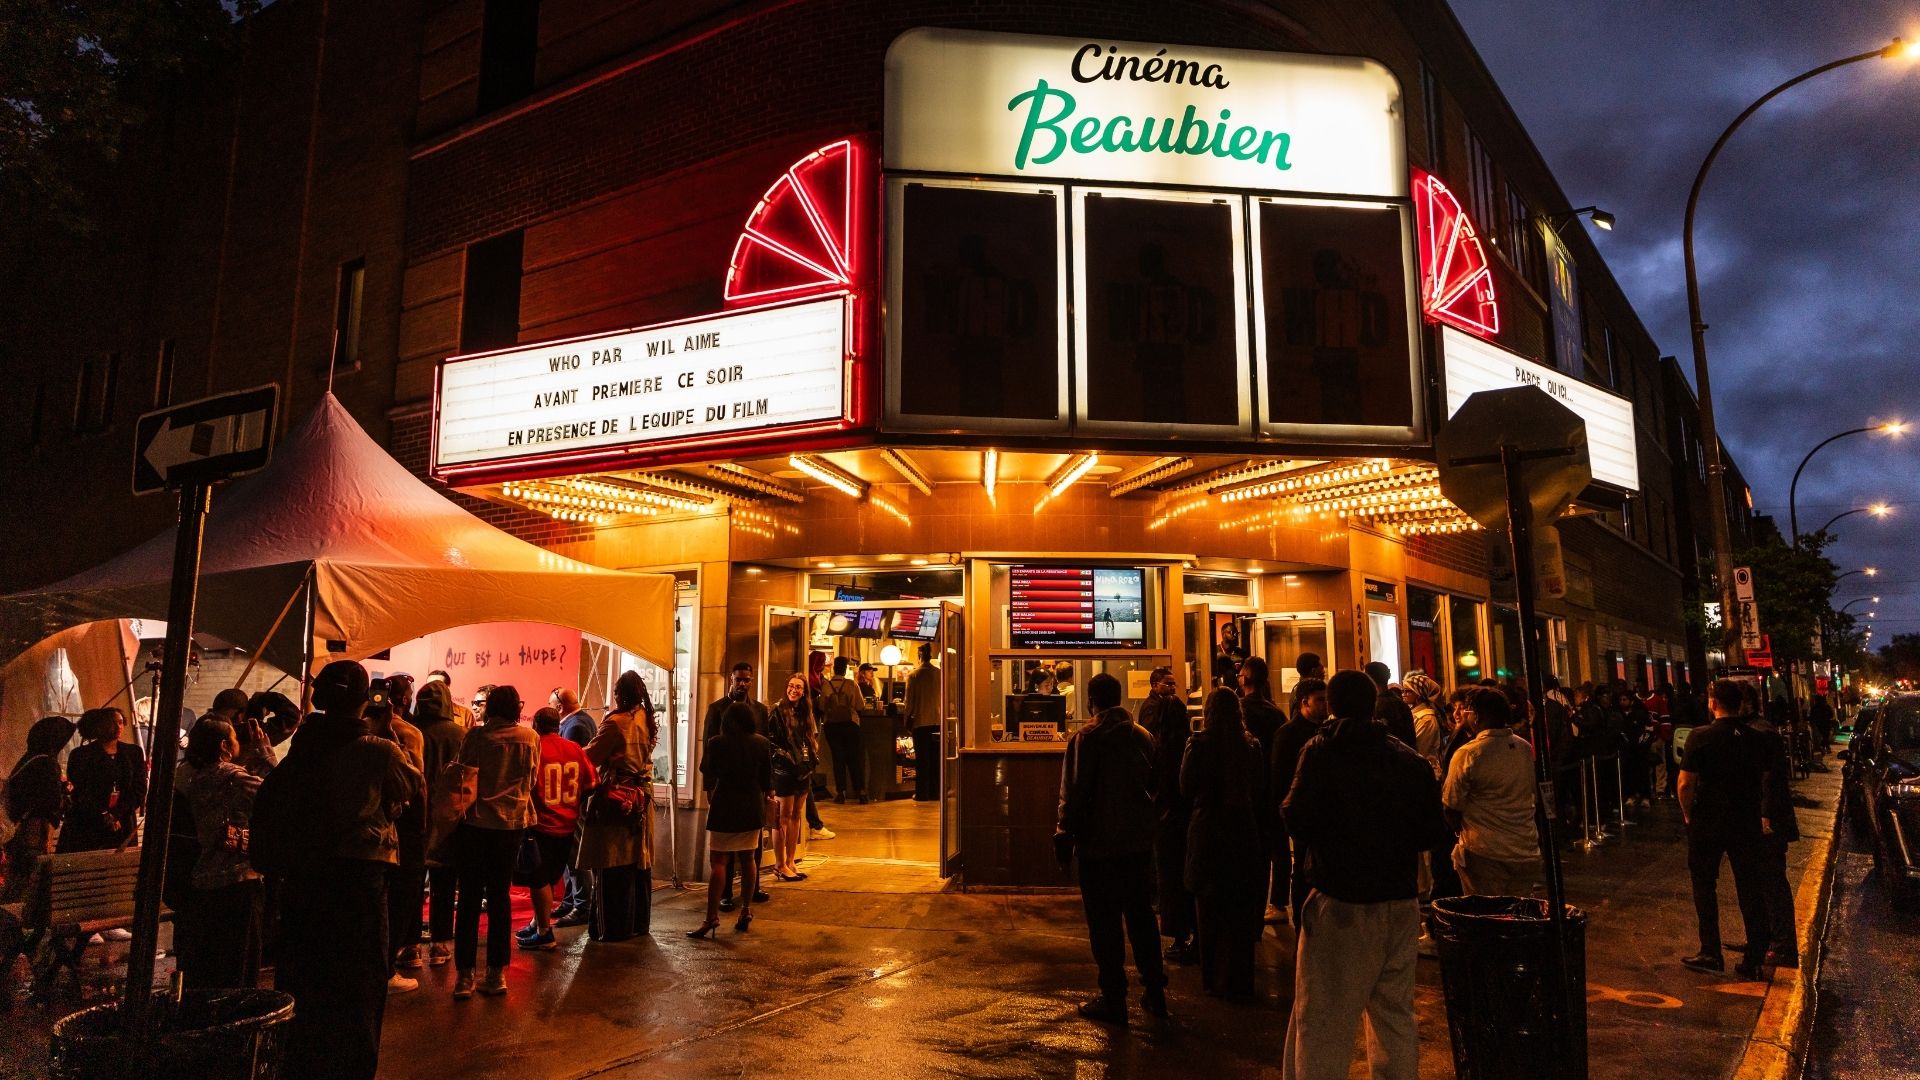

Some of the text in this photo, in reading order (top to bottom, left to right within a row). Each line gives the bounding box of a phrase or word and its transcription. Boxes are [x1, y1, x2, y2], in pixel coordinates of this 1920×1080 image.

[1071, 43, 1230, 89] Cinéma
[1007, 79, 1292, 170] Beaubien
[549, 332, 720, 372] WHO PAR WIL AIME
[534, 365, 743, 408] AVANT PREMIERE CE SOIR
[508, 430, 523, 446] EN
[527, 421, 596, 444] PRESENCE
[601, 418, 618, 435] DE
[642, 408, 695, 430] EQUIPE
[706, 404, 726, 422] DU
[732, 398, 768, 419] FILM
[445, 648, 466, 669] QUI
[499, 651, 510, 666] LA
[544, 761, 580, 806] 03
